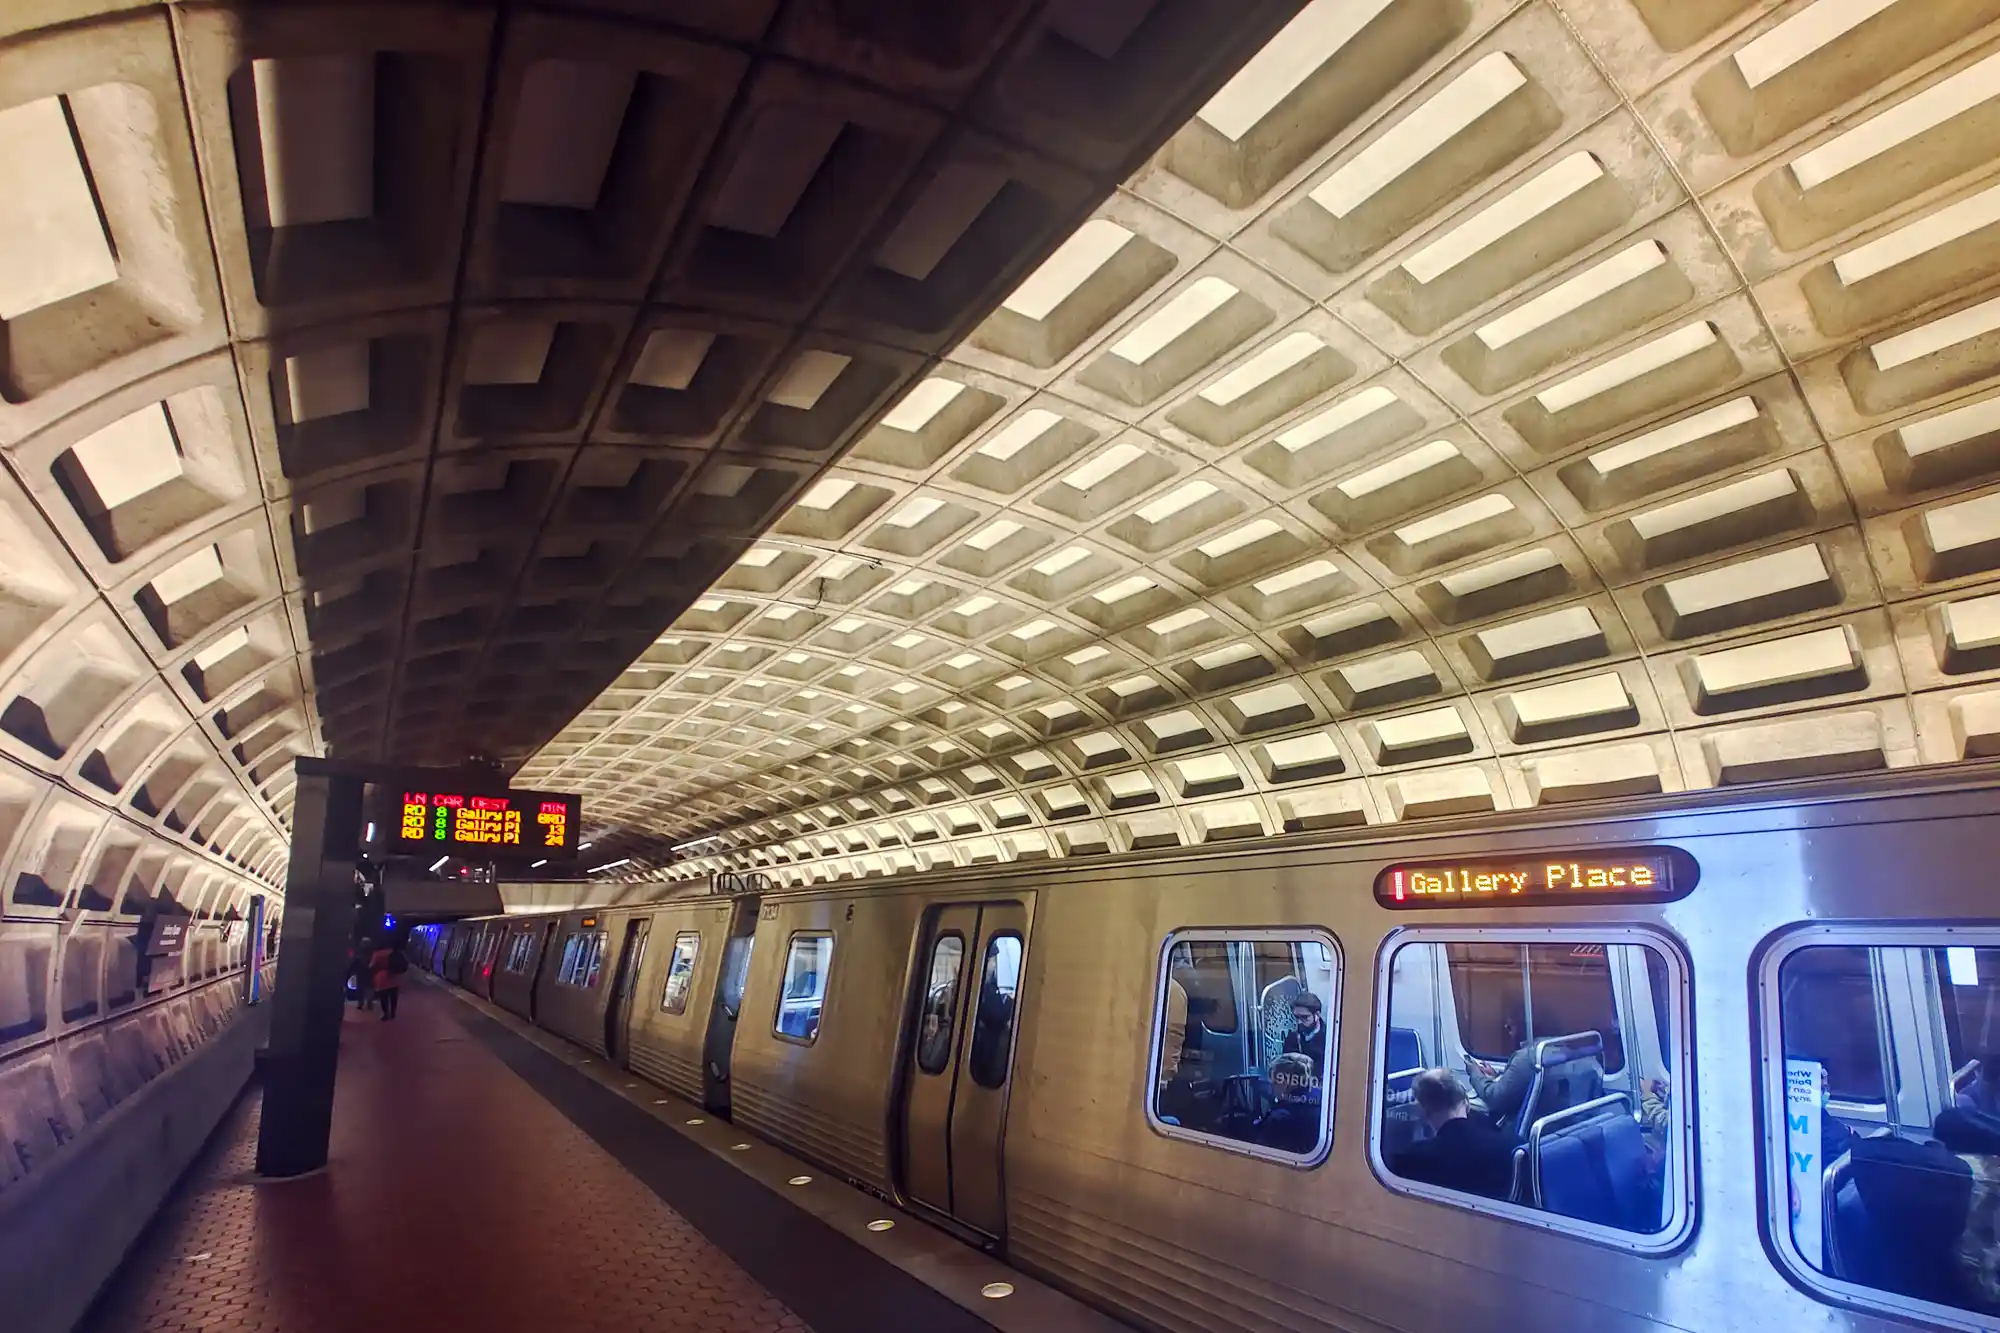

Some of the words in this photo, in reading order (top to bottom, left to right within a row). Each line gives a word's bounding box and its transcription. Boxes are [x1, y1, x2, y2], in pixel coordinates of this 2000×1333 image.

[404, 792, 427, 805] LN
[433, 795, 464, 808] CAR
[471, 797, 510, 810] DEST
[541, 802, 567, 813] MIN
[404, 804, 426, 816] RD
[436, 807, 447, 817] 8
[456, 808, 502, 822] Gallry
[505, 811, 521, 822] Pl
[537, 813, 565, 825] BRD
[403, 816, 425, 828] RD
[435, 818, 446, 829] 8
[456, 819, 502, 833] Gallry
[505, 822, 520, 833] Pl
[549, 825, 564, 835] 13
[401, 827, 424, 840] RD
[434, 829, 446, 840] 8
[455, 830, 501, 844] Gallry
[504, 833, 520, 844] Pl
[544, 835, 564, 846] 24
[1411, 871, 1528, 894] Gallery
[1546, 863, 1654, 889] Place
